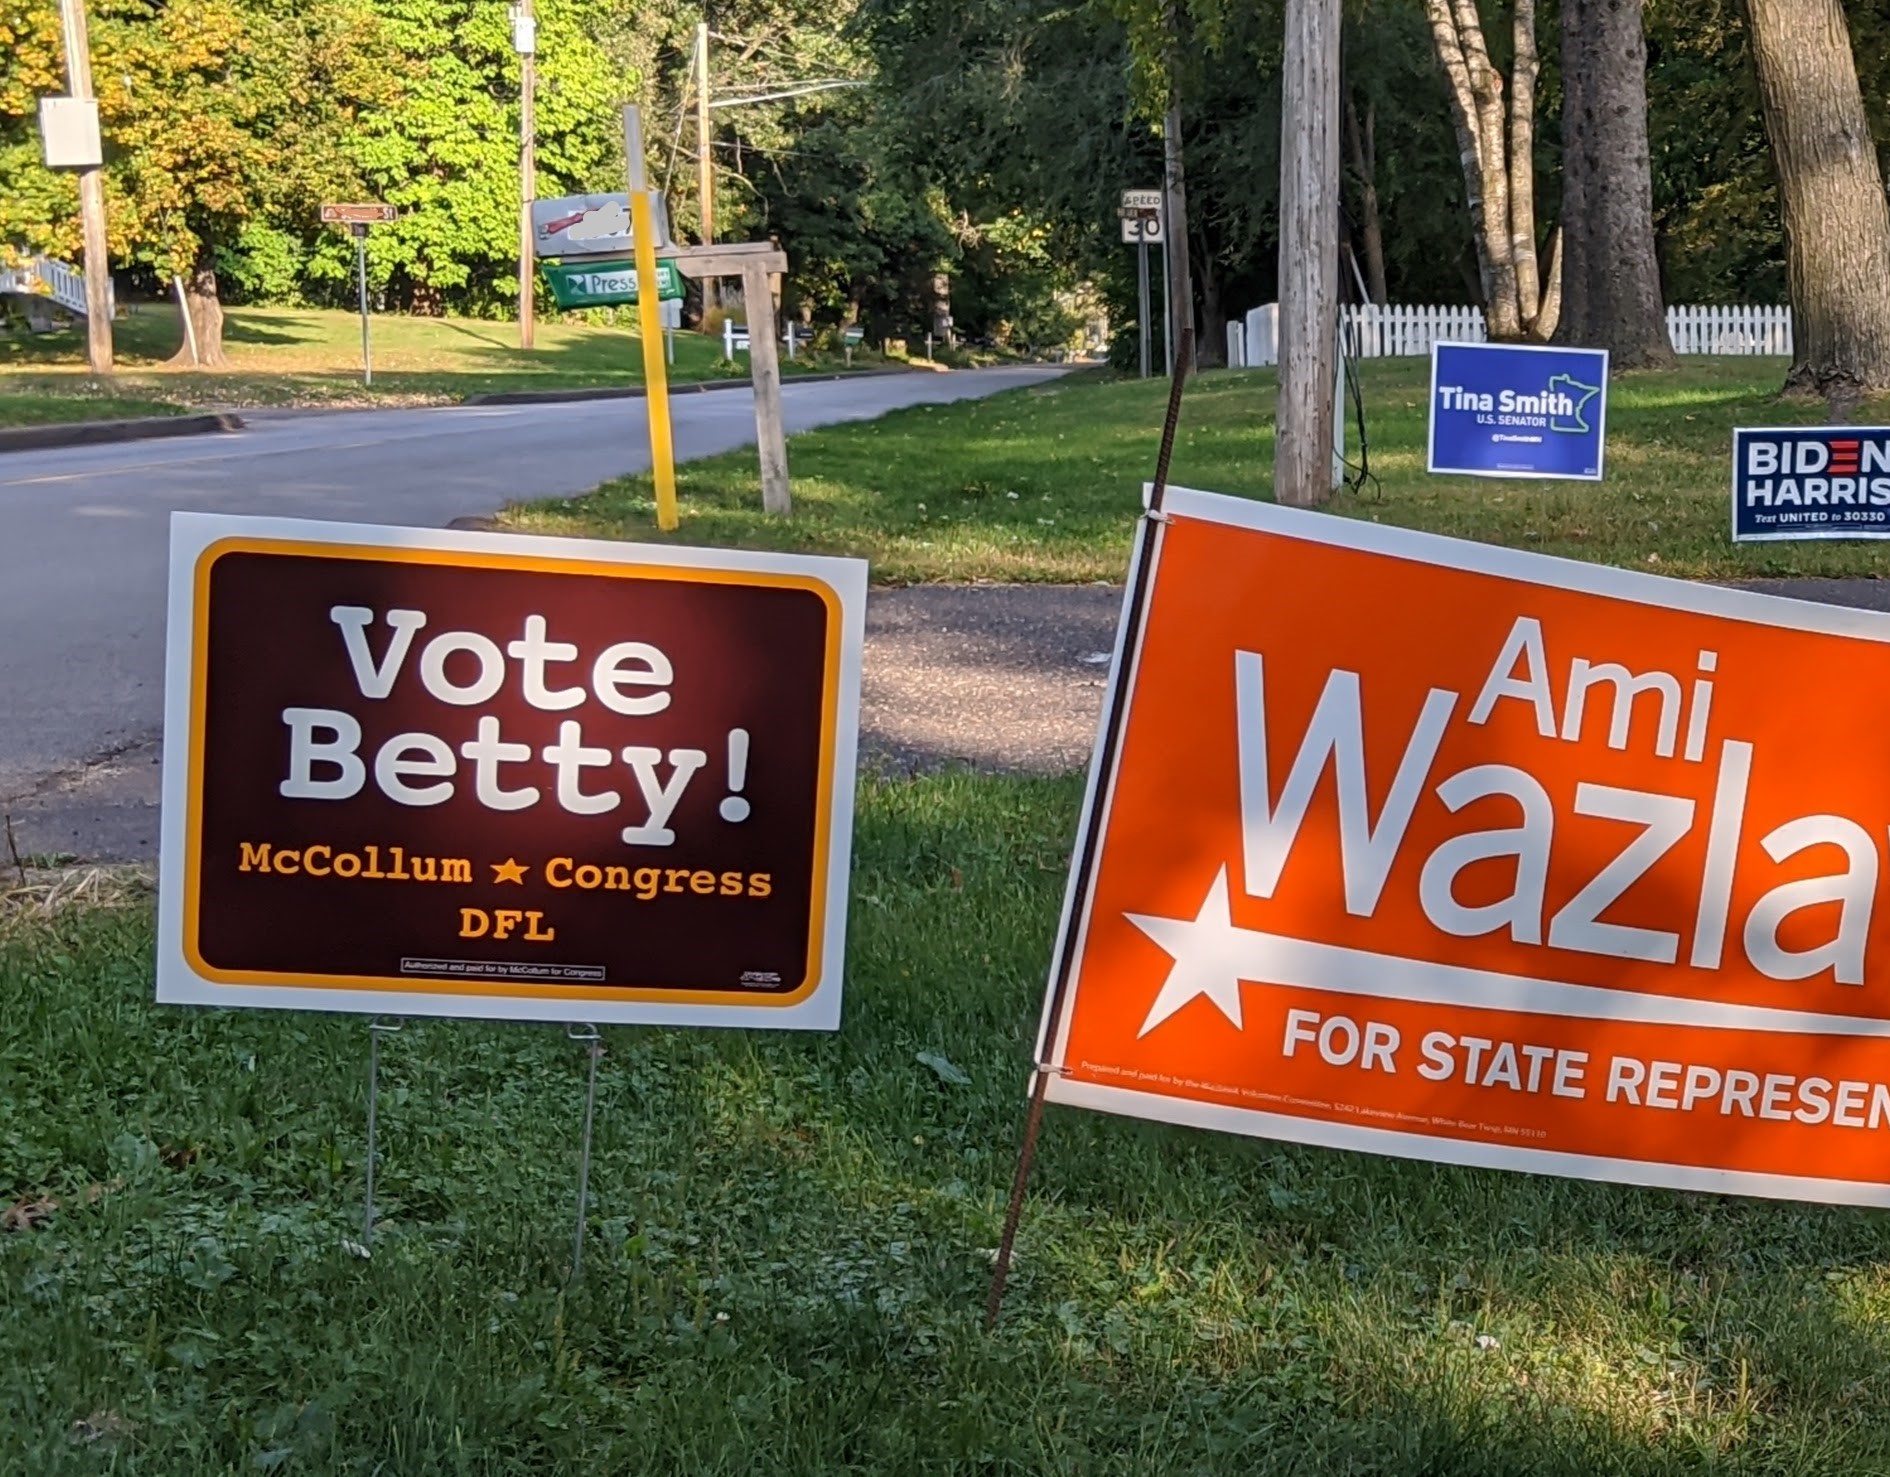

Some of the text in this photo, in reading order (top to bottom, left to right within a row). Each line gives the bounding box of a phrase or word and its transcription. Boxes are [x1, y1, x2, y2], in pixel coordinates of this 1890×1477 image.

[1124, 196, 1160, 205] SPEED
[1128, 218, 1160, 236] 30
[592, 275, 636, 292] Press
[1439, 386, 1573, 416] Tina Smith
[1477, 414, 1546, 427] U.S. SENATOR
[1755, 514, 1777, 523] Text
[1779, 512, 1828, 523] UNITED
[1843, 512, 1885, 522] 30330
[330, 605, 674, 716] Vote
[1468, 615, 1719, 763] Ami
[279, 708, 752, 847] Betty!
[238, 842, 772, 900] McCollum Congress
[458, 907, 556, 943] DFL
[449, 963, 465, 972] and
[466, 963, 484, 973] paid
[485, 964, 497, 972] for
[498, 965, 508, 975] by
[551, 967, 562, 975] for
[1282, 1008, 1401, 1073] FOR
[1416, 1030, 1589, 1098] STATE
[1172, 1075, 1184, 1087] by
